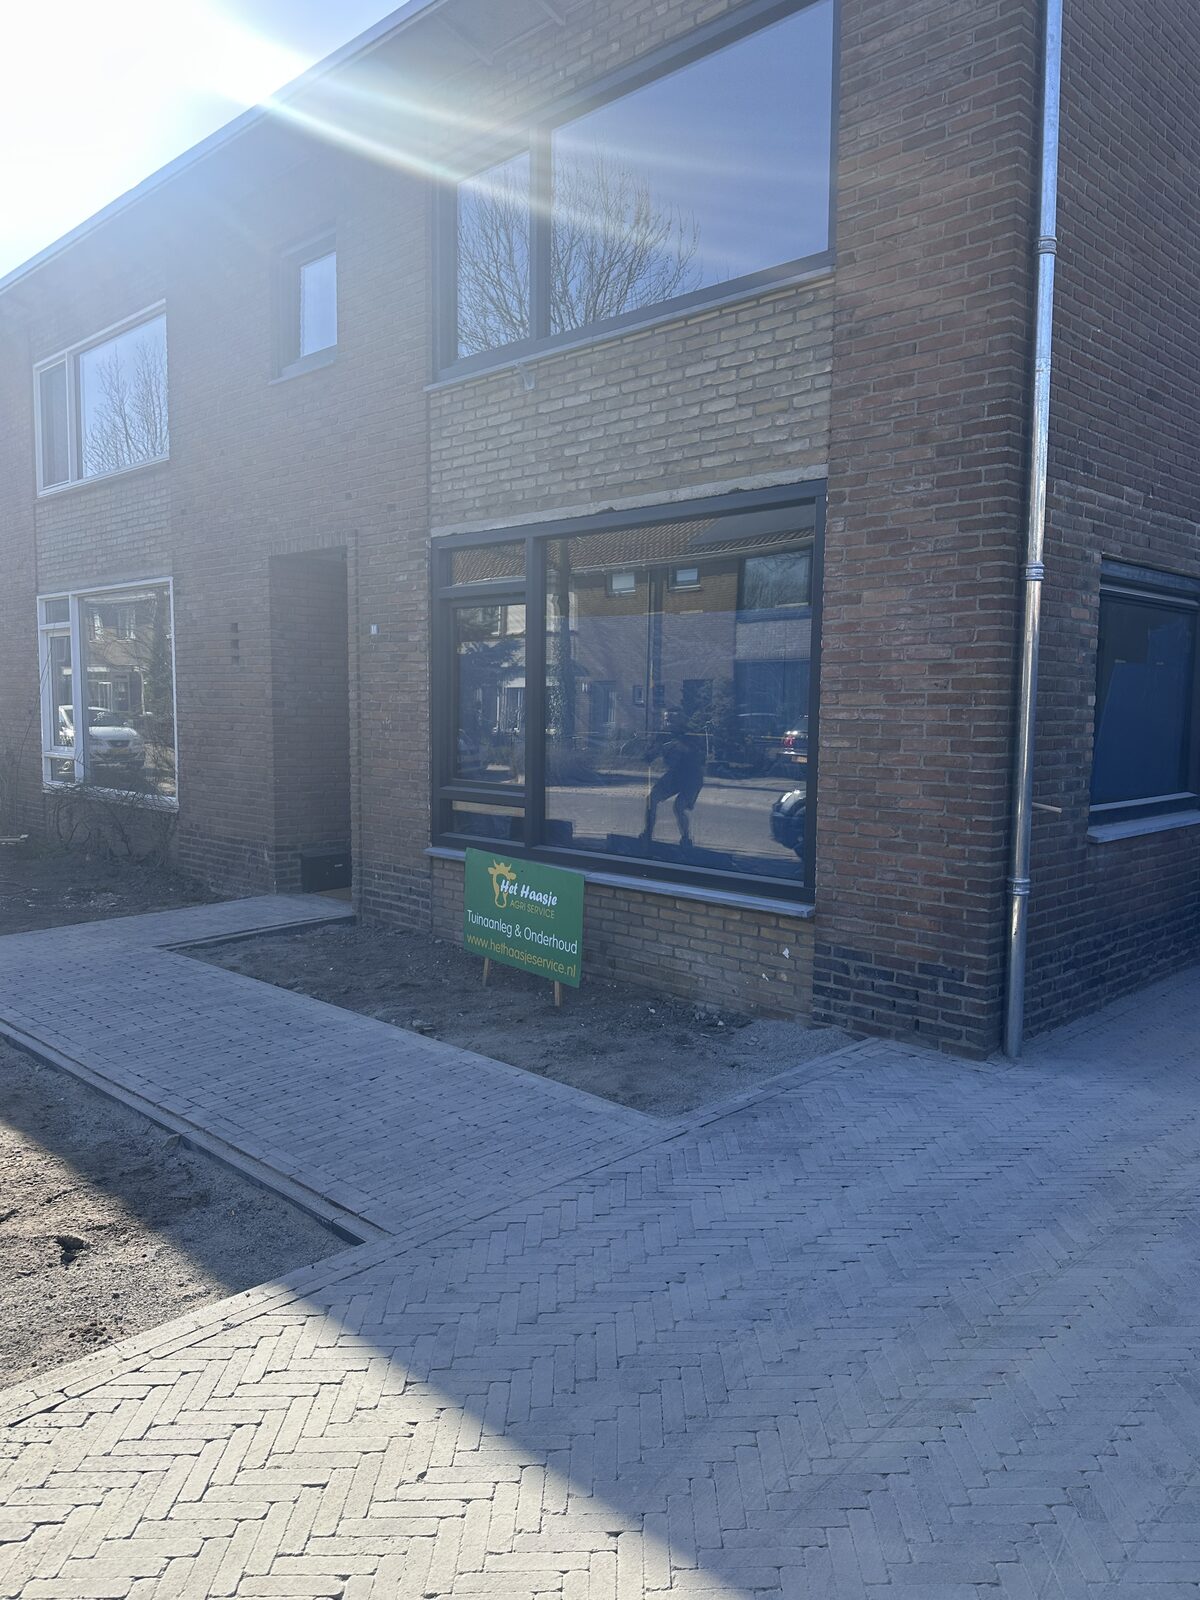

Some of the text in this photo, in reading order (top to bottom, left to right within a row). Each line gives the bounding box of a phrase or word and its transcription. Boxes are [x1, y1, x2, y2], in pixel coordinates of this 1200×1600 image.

[500, 879, 558, 907] Het Haasje
[510, 899, 555, 919] AGRI SERVICE
[467, 909, 578, 955] Tuinaanleg & Onderhoud
[466, 933, 577, 978] www.hethaasjeservice.nl
